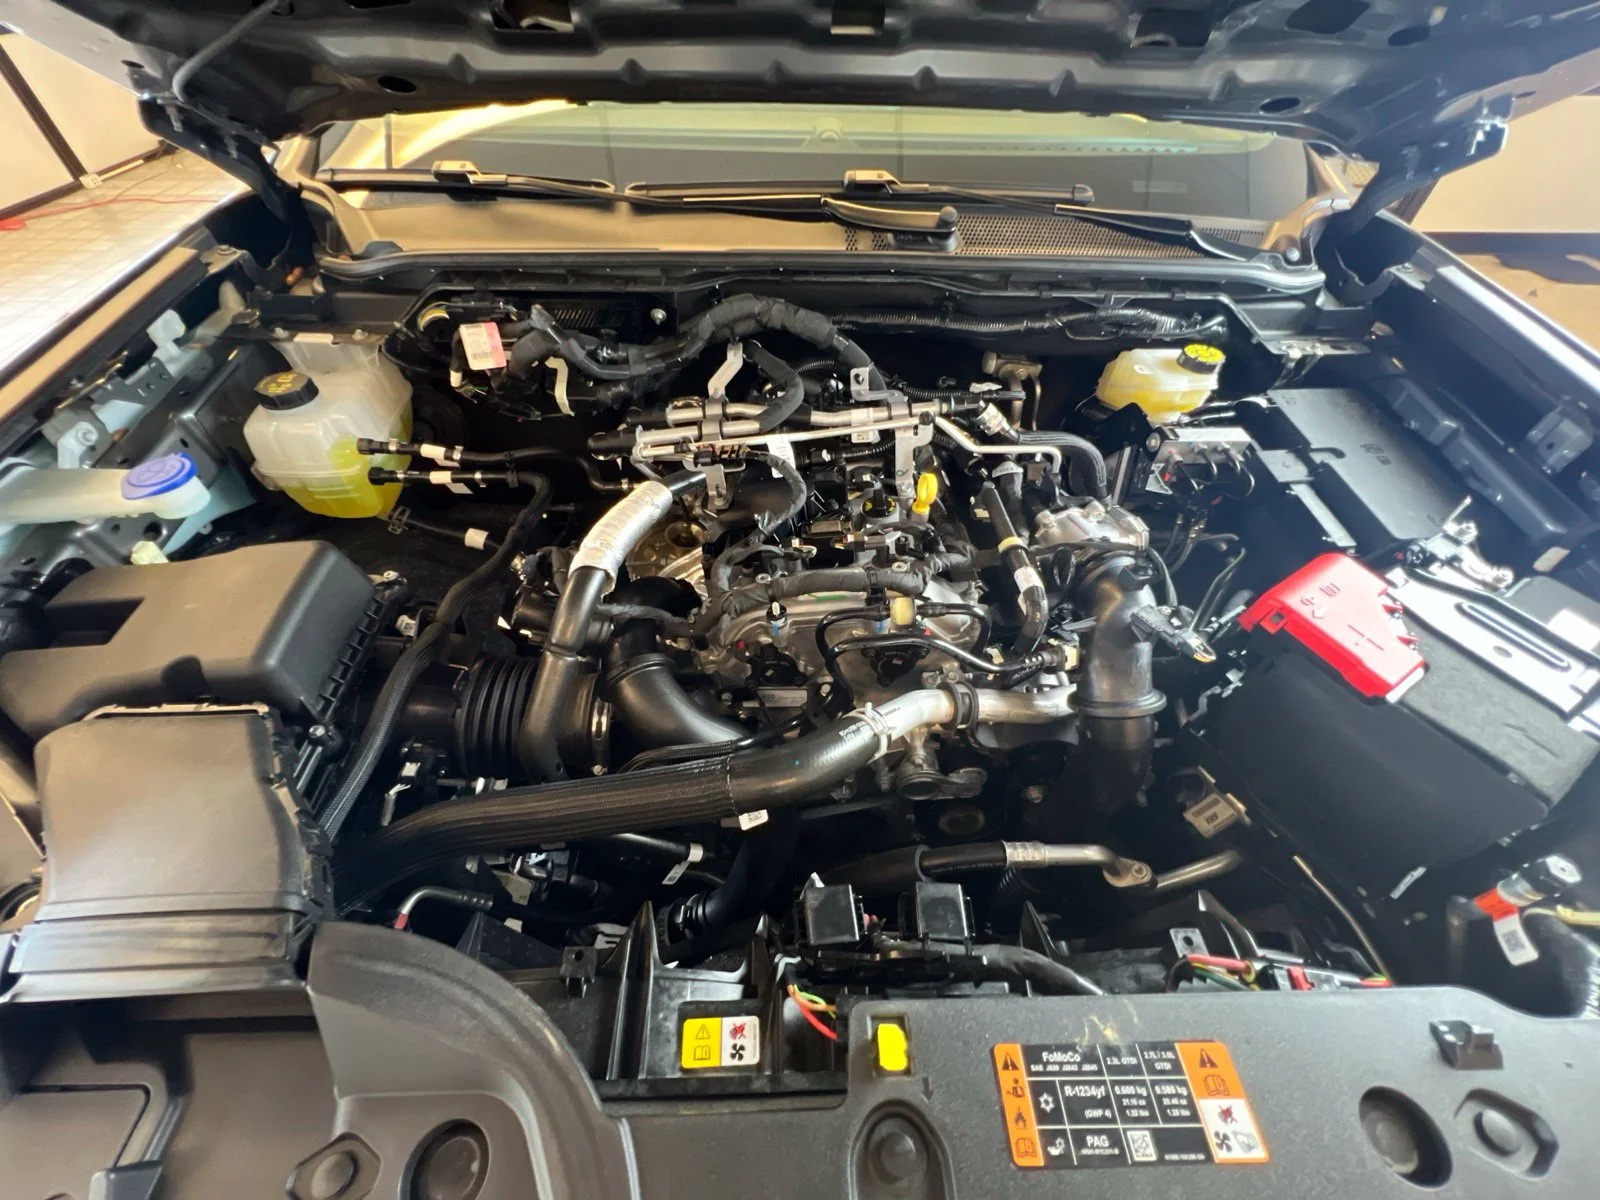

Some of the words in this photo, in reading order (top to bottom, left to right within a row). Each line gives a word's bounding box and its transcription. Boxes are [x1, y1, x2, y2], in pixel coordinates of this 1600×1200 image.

[1042, 1051, 1081, 1062] FoMoCo
[1121, 1056, 1138, 1065] GTDI
[1030, 1064, 1044, 1072] SAE
[1154, 1062, 1172, 1070] GTDI
[1064, 1085, 1105, 1099] R-1234yf
[1114, 1085, 1136, 1095] 0.600
[1136, 1085, 1148, 1097] kg
[1176, 1085, 1188, 1096] kg
[1084, 1108, 1103, 1119] (GWP
[1104, 1108, 1112, 1119] 4)
[1086, 1135, 1110, 1148] PAG
